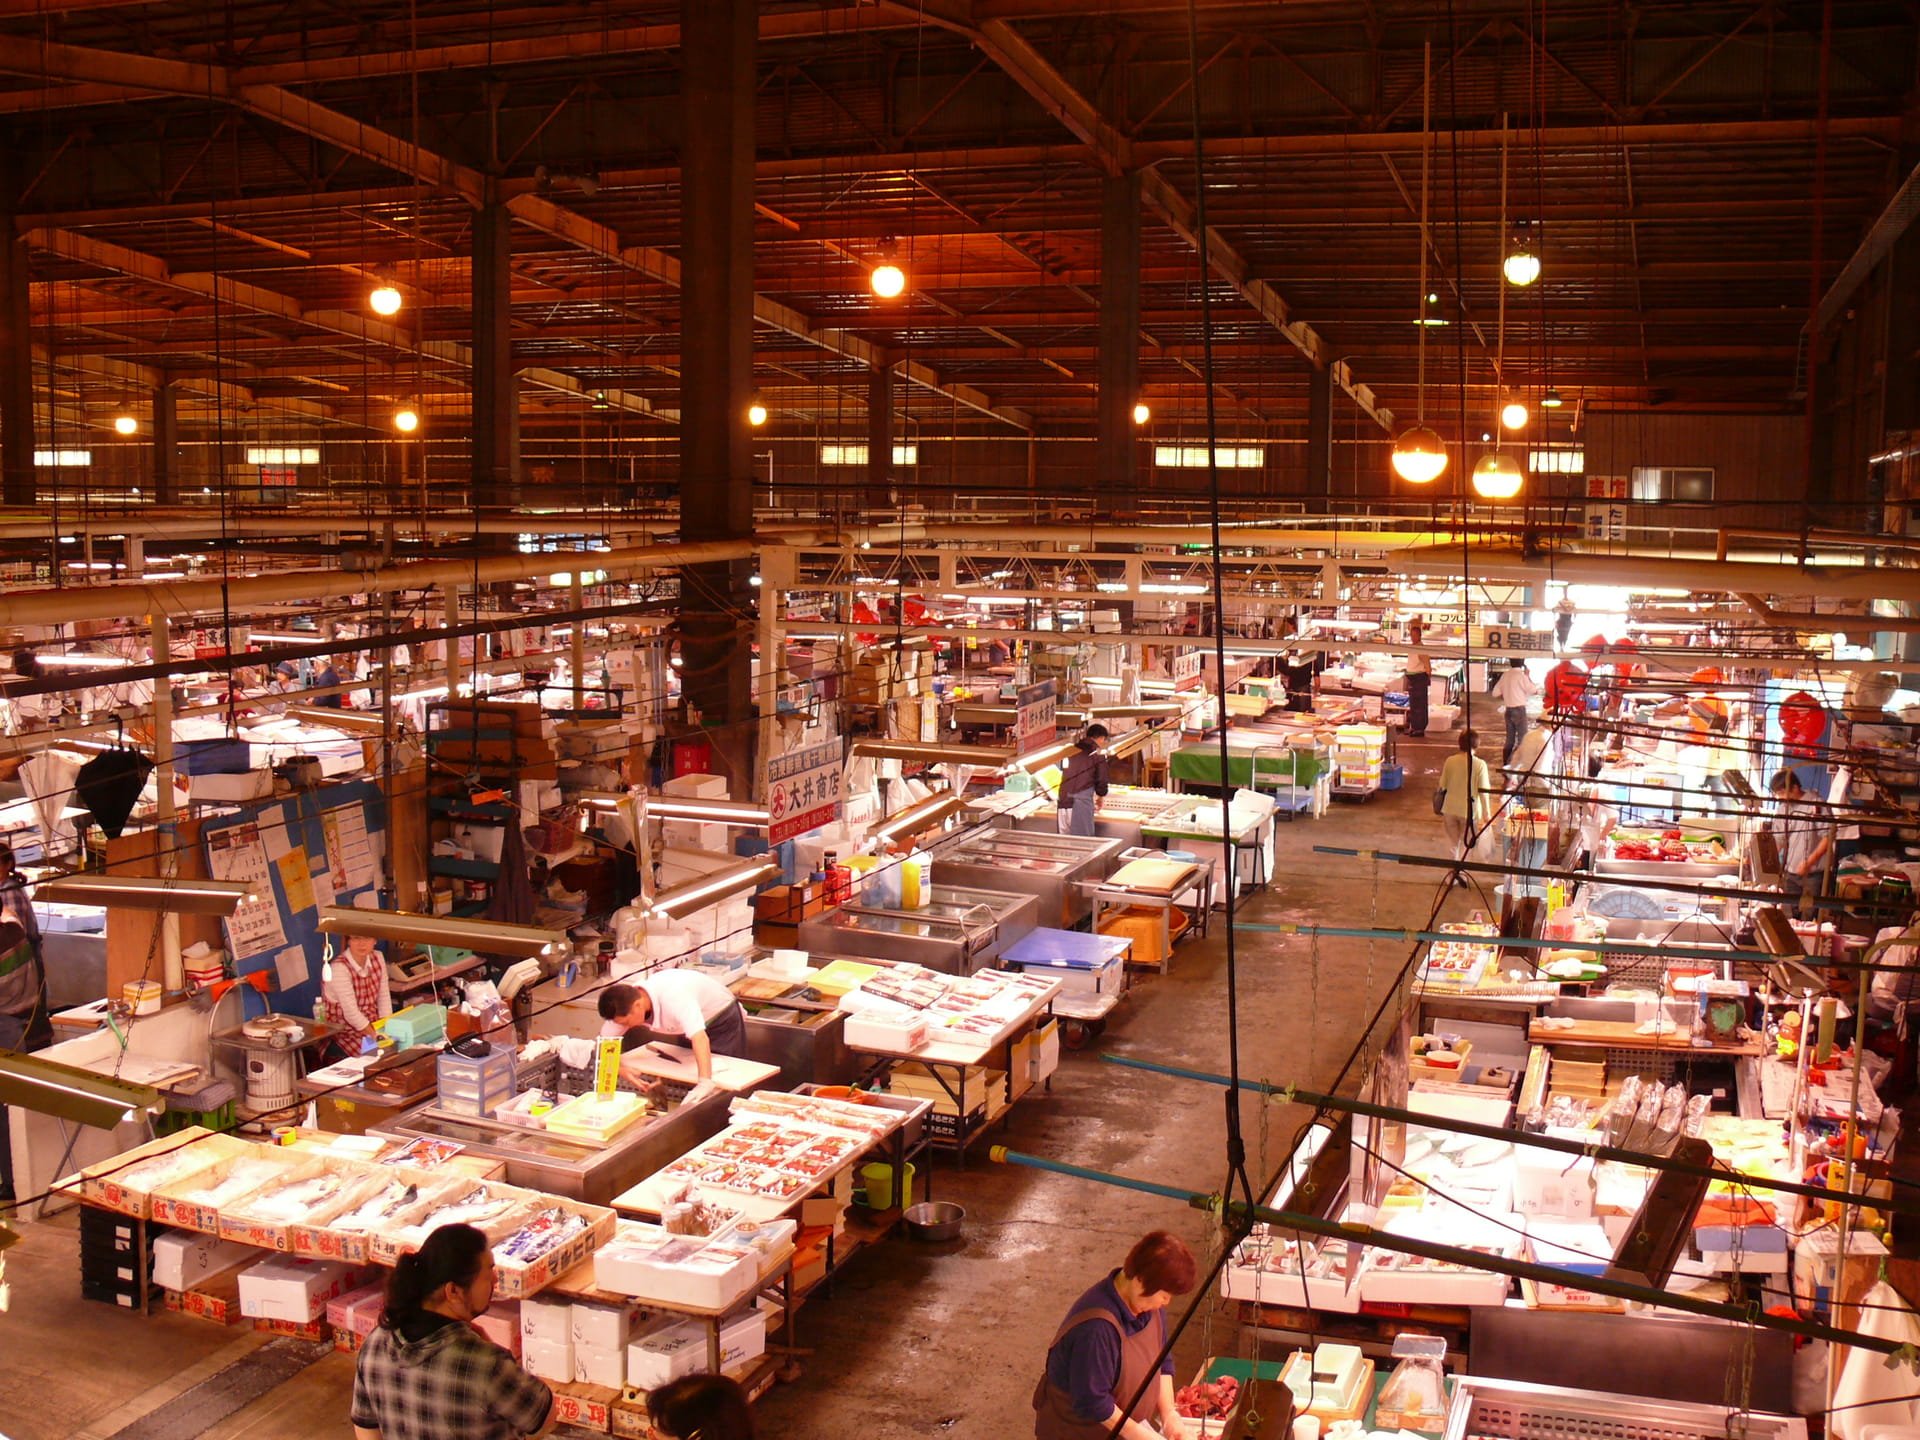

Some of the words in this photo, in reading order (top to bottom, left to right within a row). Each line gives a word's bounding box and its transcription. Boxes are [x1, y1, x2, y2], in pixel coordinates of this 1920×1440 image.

[789, 768, 840, 812] 大井商店
[132, 1202, 140, 1214] 5
[276, 1236, 285, 1249] 6
